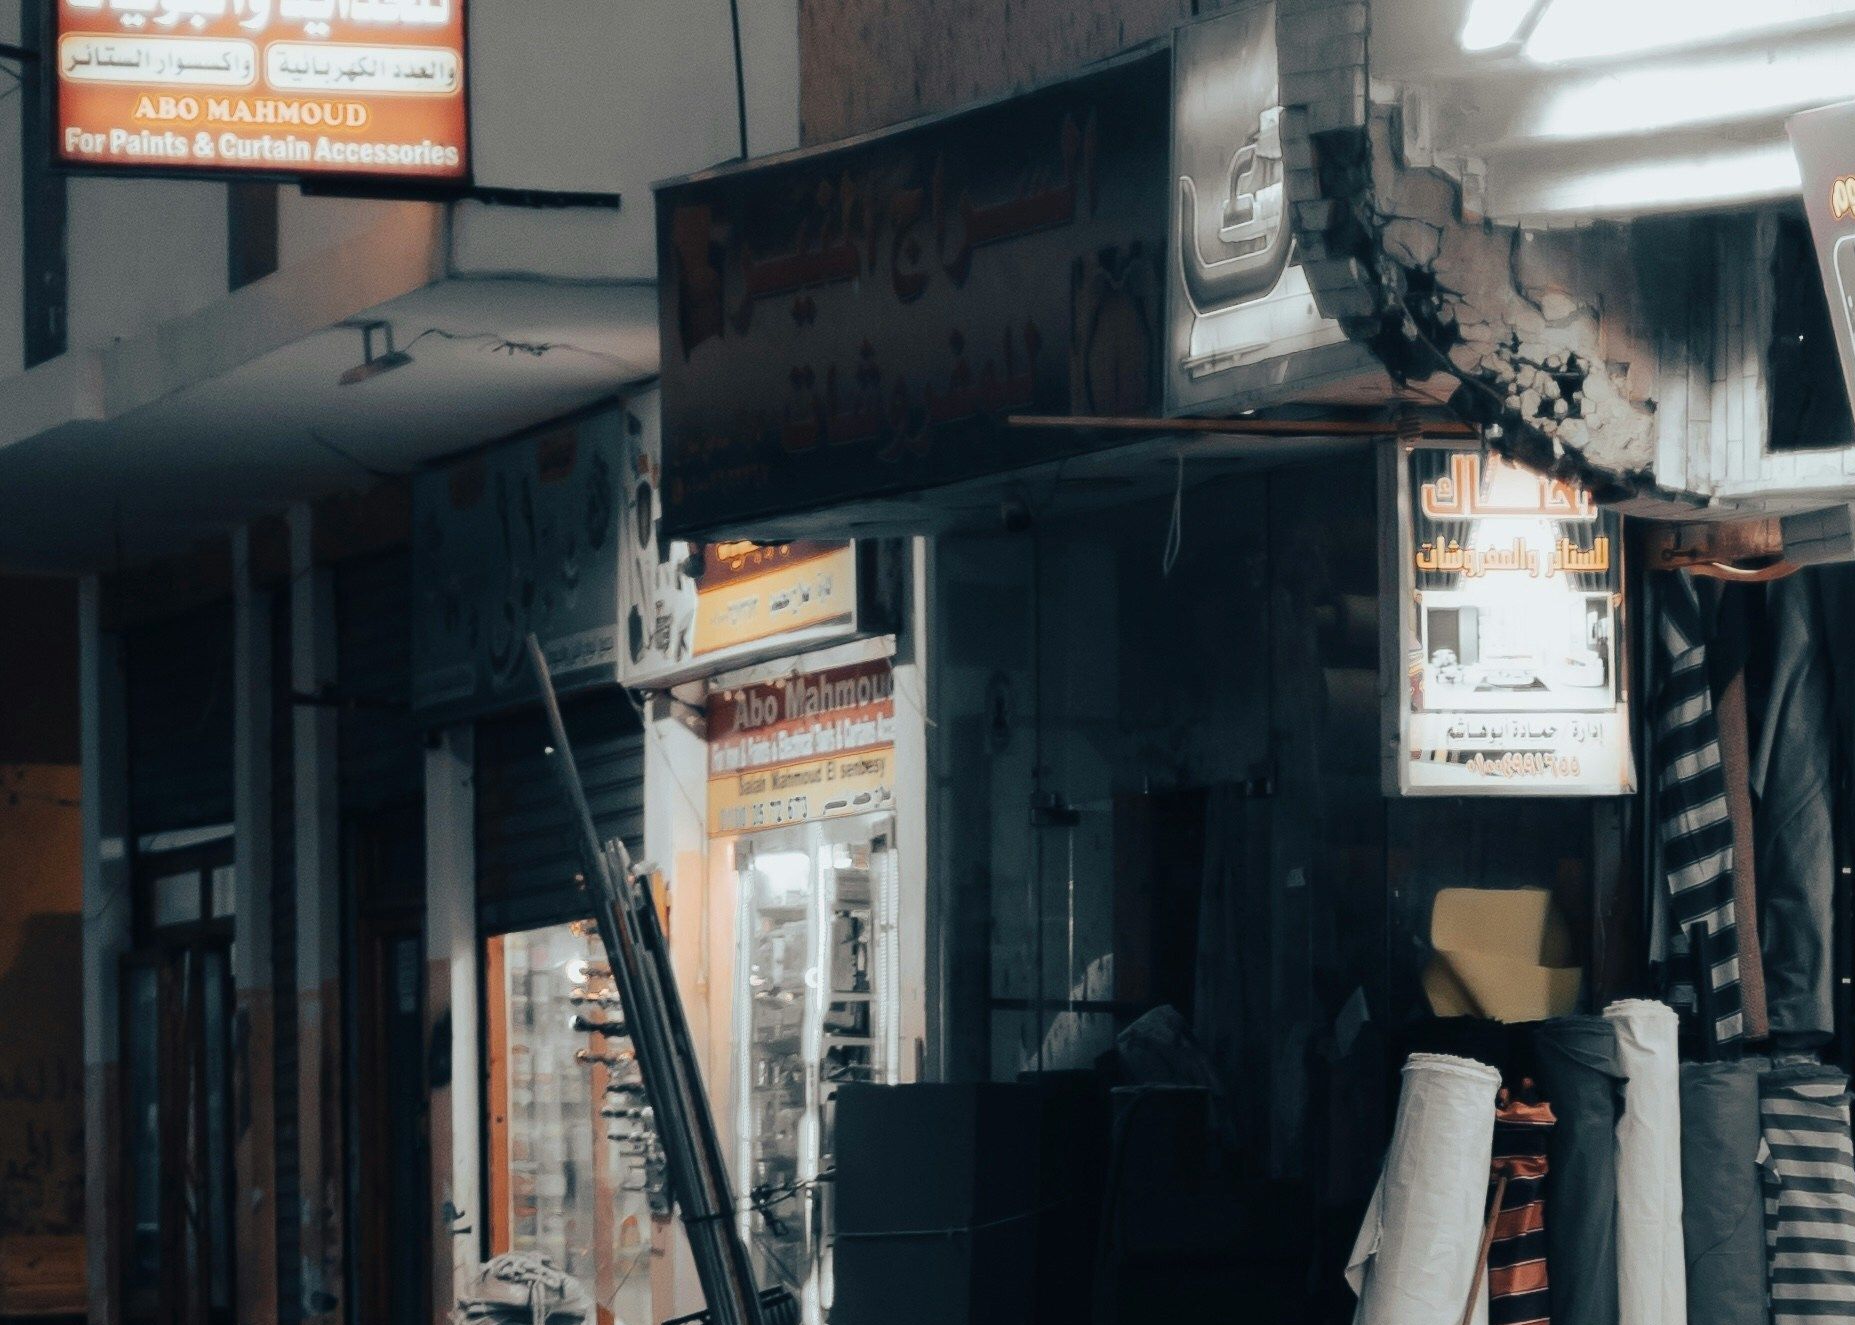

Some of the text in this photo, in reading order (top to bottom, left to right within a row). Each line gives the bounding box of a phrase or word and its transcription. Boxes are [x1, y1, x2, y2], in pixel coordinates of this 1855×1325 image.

[134, 96, 367, 128] ABO MAHMOUD
[65, 126, 460, 167] For Paints & Curtain Accessories
[733, 686, 779, 732] Abo
